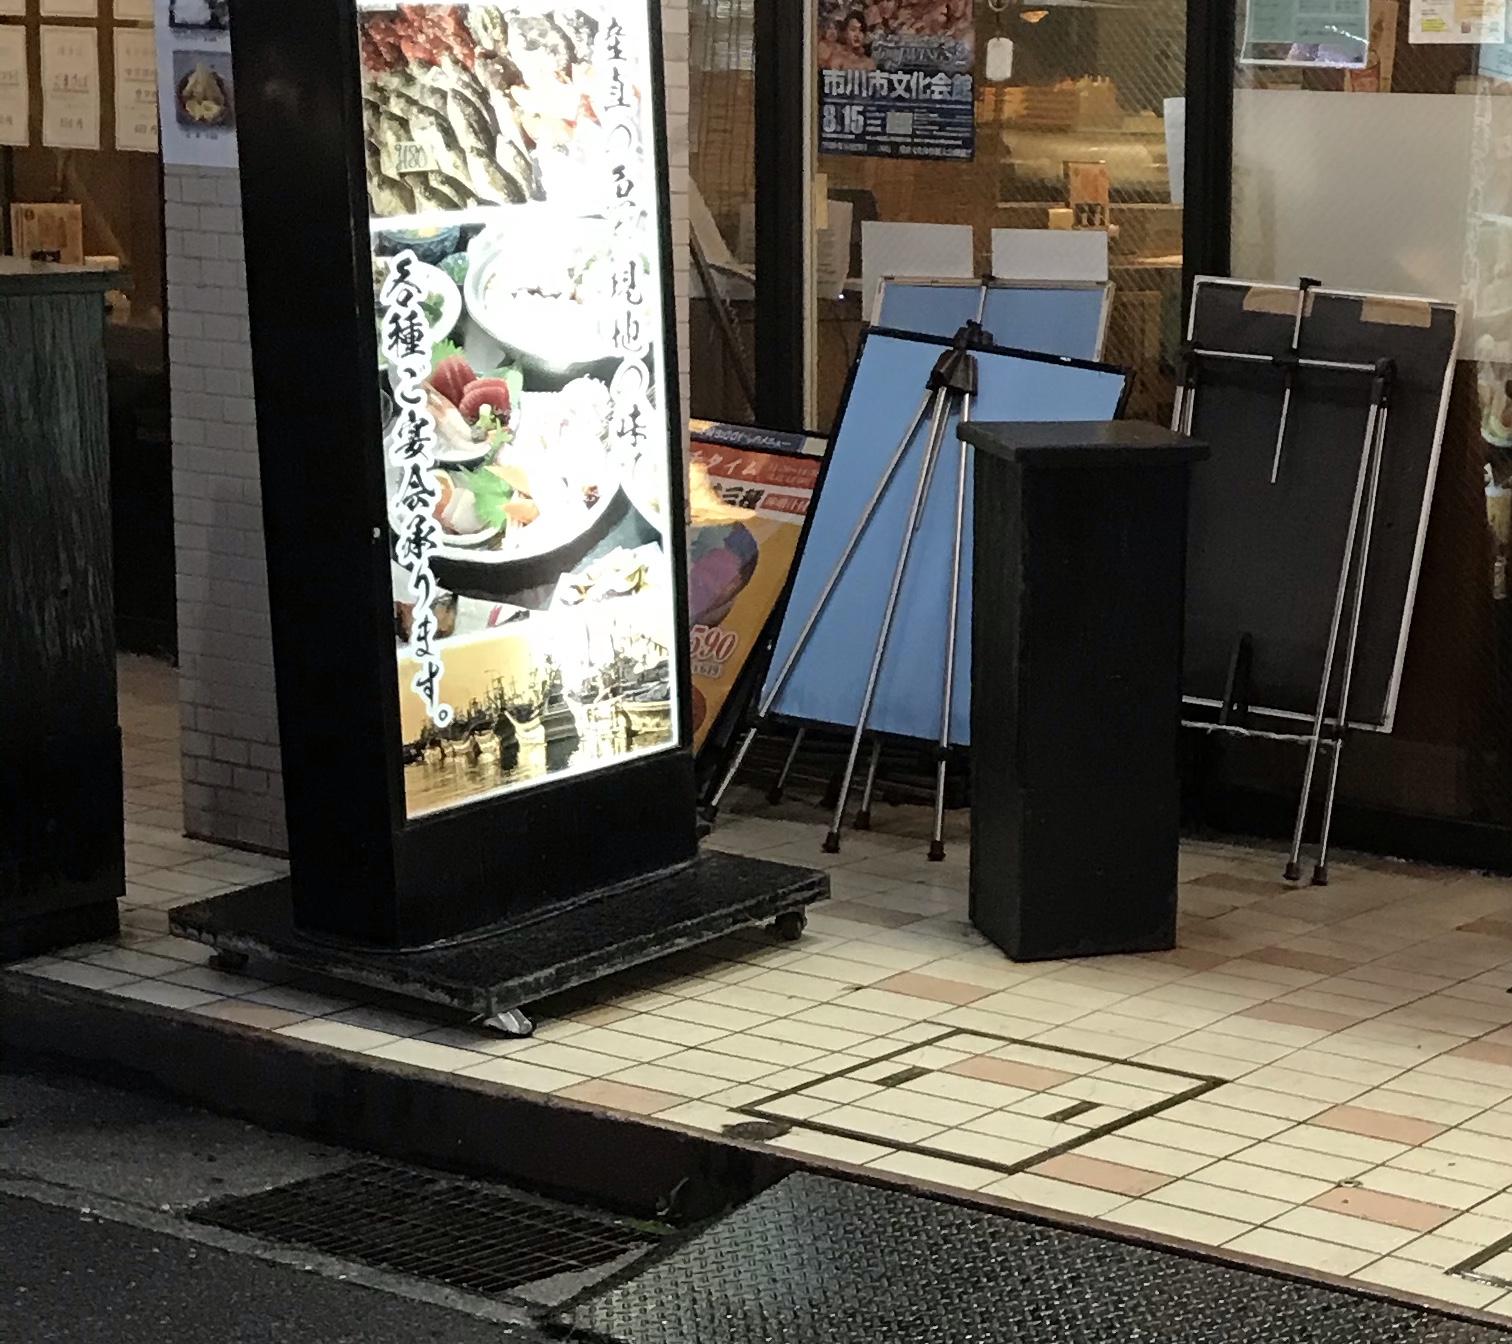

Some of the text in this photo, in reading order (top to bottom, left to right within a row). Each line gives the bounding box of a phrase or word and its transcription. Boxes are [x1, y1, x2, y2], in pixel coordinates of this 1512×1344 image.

[822, 69, 973, 100] 市川市文化会館
